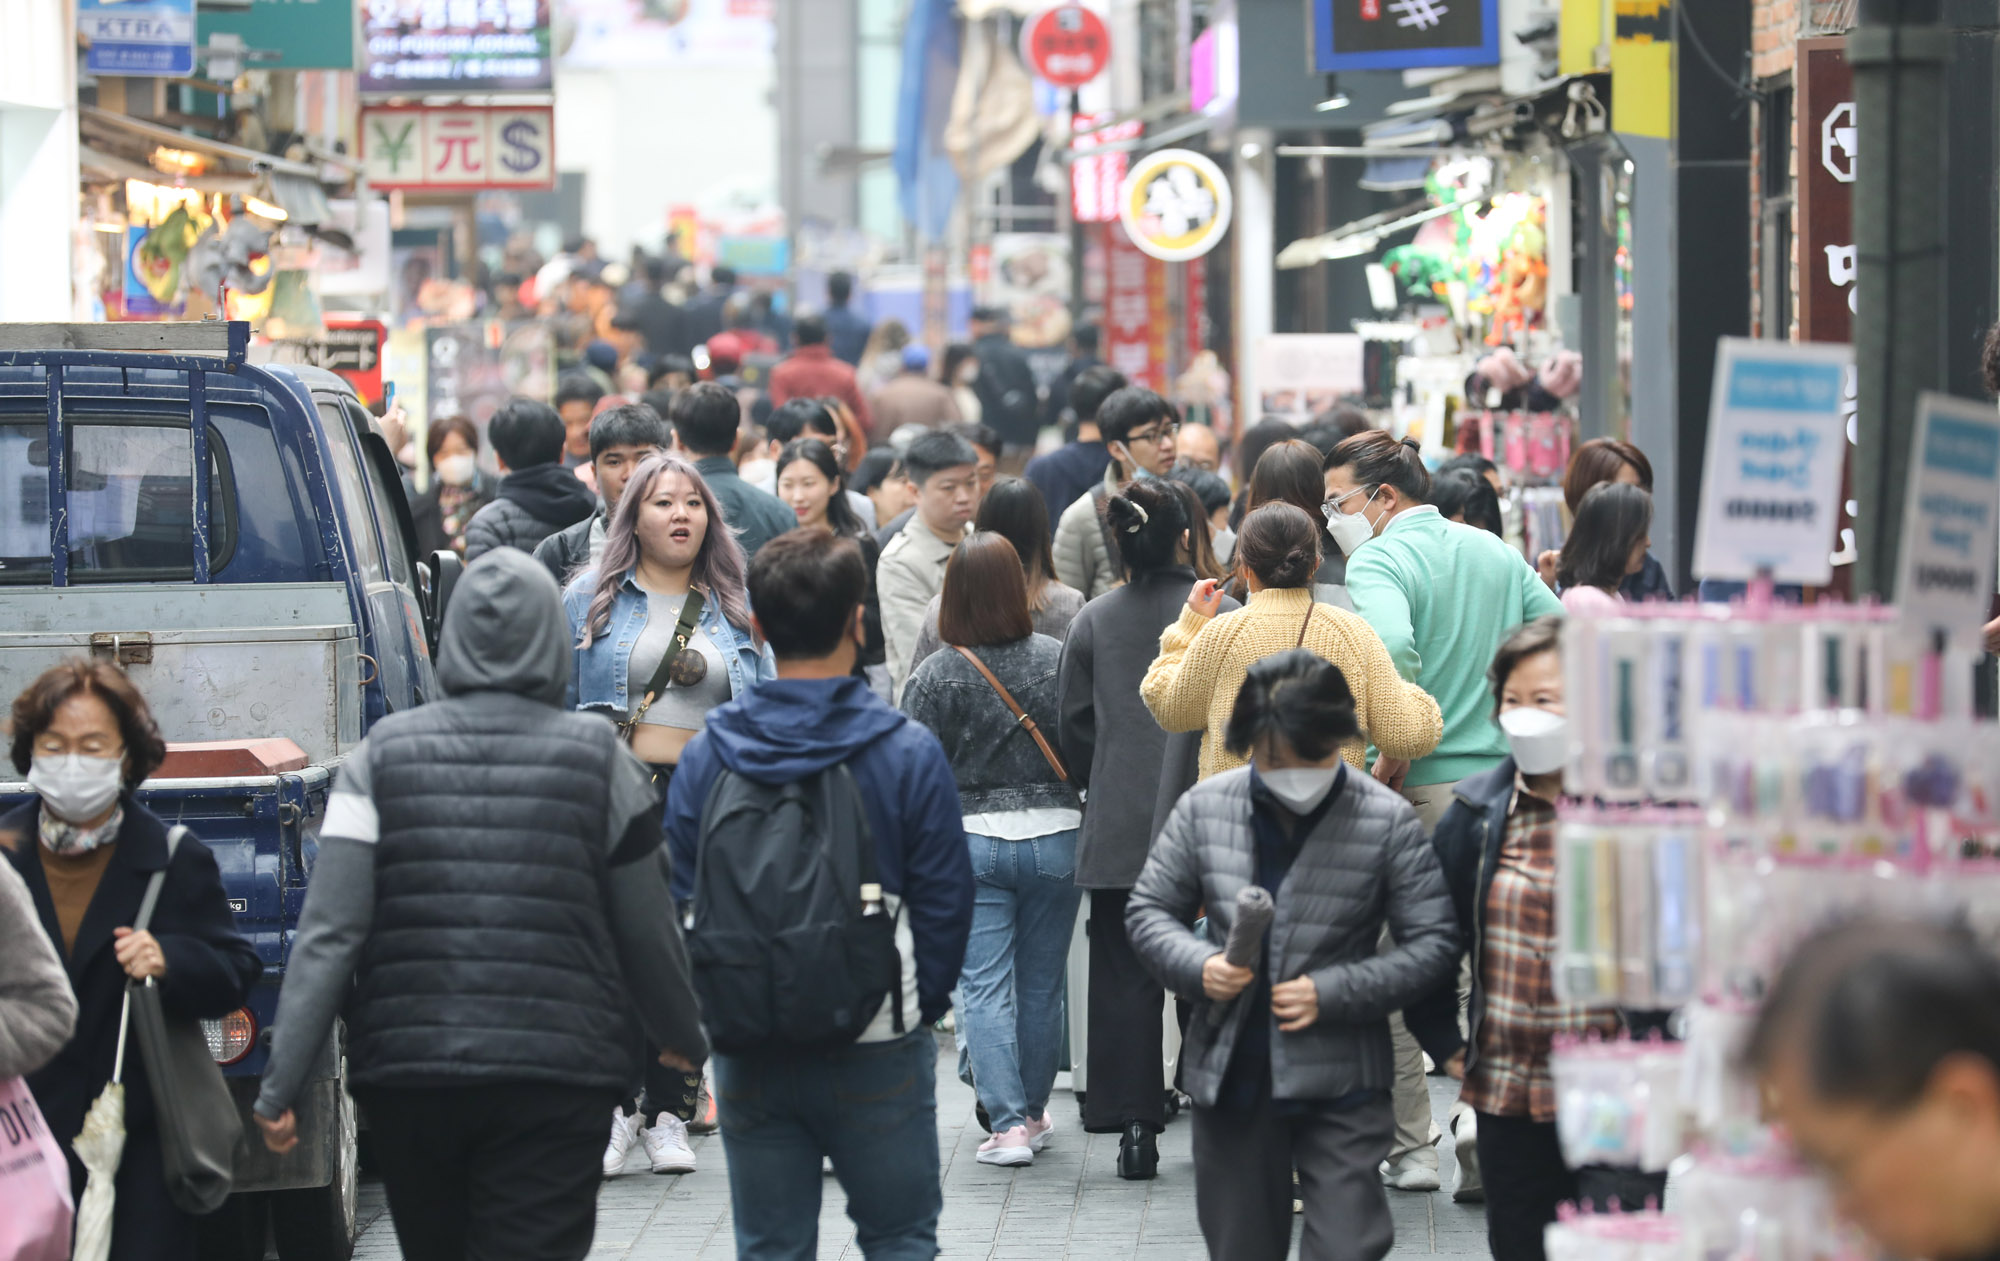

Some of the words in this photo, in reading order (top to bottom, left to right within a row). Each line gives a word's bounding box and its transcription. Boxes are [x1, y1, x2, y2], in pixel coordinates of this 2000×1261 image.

[373, 119, 415, 174] ¥
[435, 120, 482, 172] 元
[502, 118, 541, 173] $
